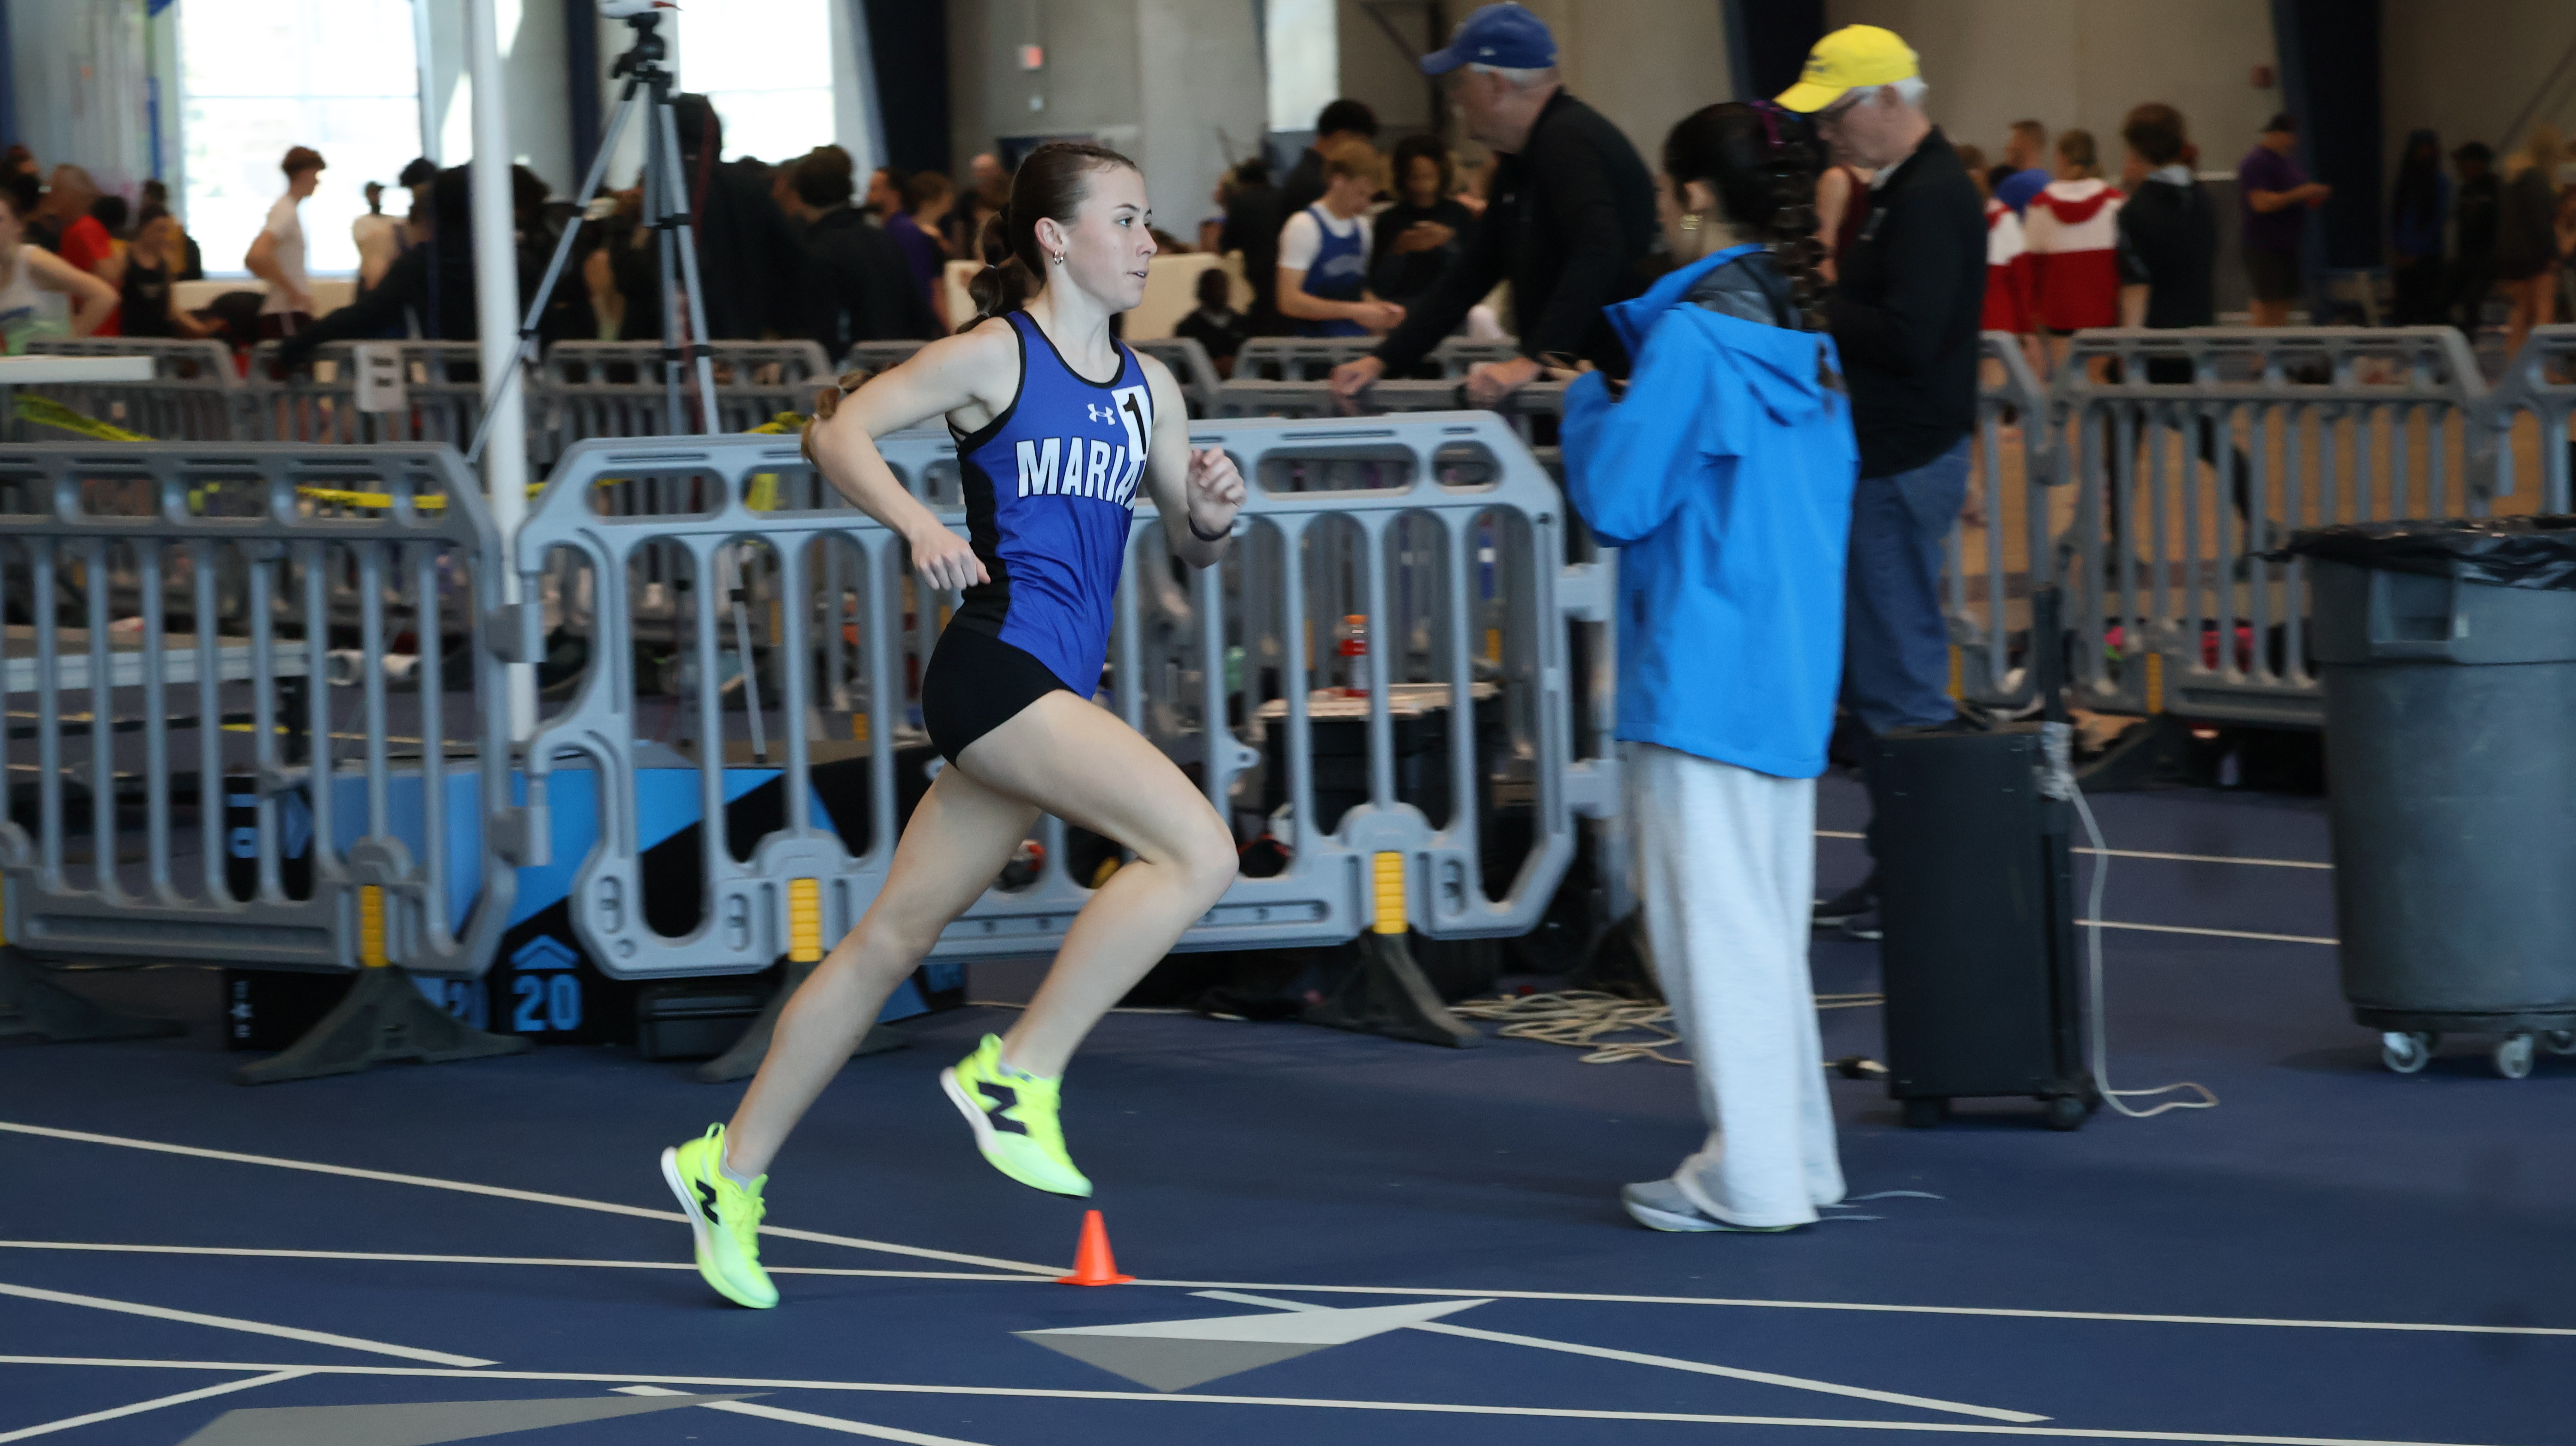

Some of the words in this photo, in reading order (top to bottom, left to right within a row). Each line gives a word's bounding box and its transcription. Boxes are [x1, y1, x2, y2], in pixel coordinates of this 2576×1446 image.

[1123, 392, 1147, 456] 1
[1016, 436, 1142, 512] MARIA
[513, 973, 581, 1031] 20
